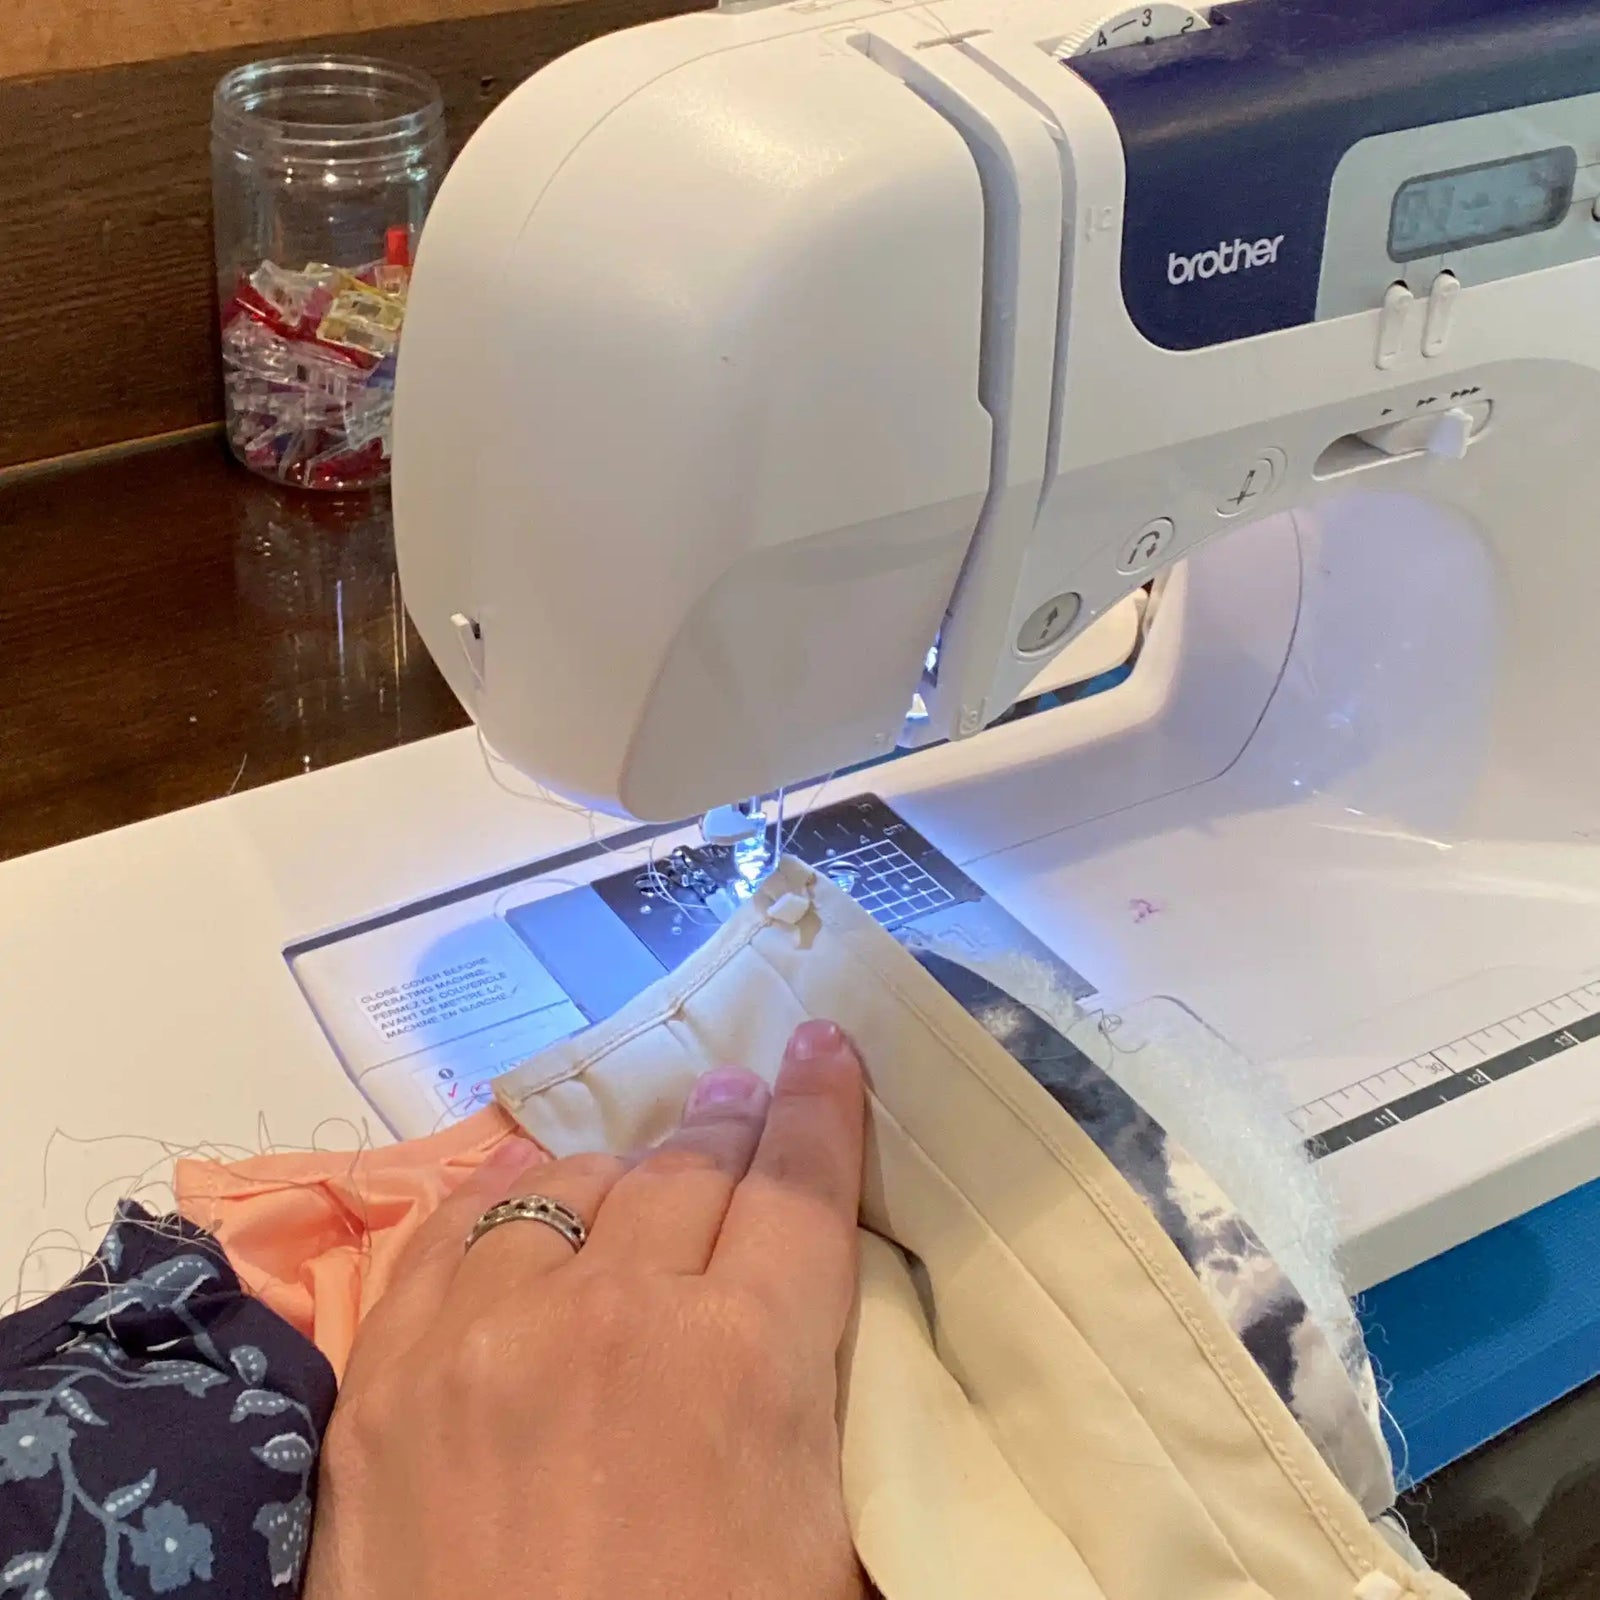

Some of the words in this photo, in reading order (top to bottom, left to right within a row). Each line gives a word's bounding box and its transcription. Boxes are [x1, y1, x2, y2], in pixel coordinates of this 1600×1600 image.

[1141, 8, 1153, 28] 3
[1180, 16, 1195, 34] 2
[1167, 234, 1285, 286] brother
[360, 986, 400, 1004] CLOSE
[401, 972, 441, 990] COVER
[442, 956, 490, 977] BEFORE
[367, 986, 434, 1012] OPERATING
[372, 1001, 420, 1021] FERMEZ
[439, 971, 508, 999] COUVERCLE
[381, 1012, 418, 1031] AVANT
[420, 1005, 437, 1016] DE
[438, 990, 486, 1010] METTRE
[385, 1015, 440, 1039] MACHINE
[440, 1009, 459, 1021] EN
[1554, 1034, 1573, 1048] 13
[1425, 1062, 1445, 1075] 30
[1467, 1073, 1486, 1086] 12
[1374, 1114, 1393, 1127] 11
